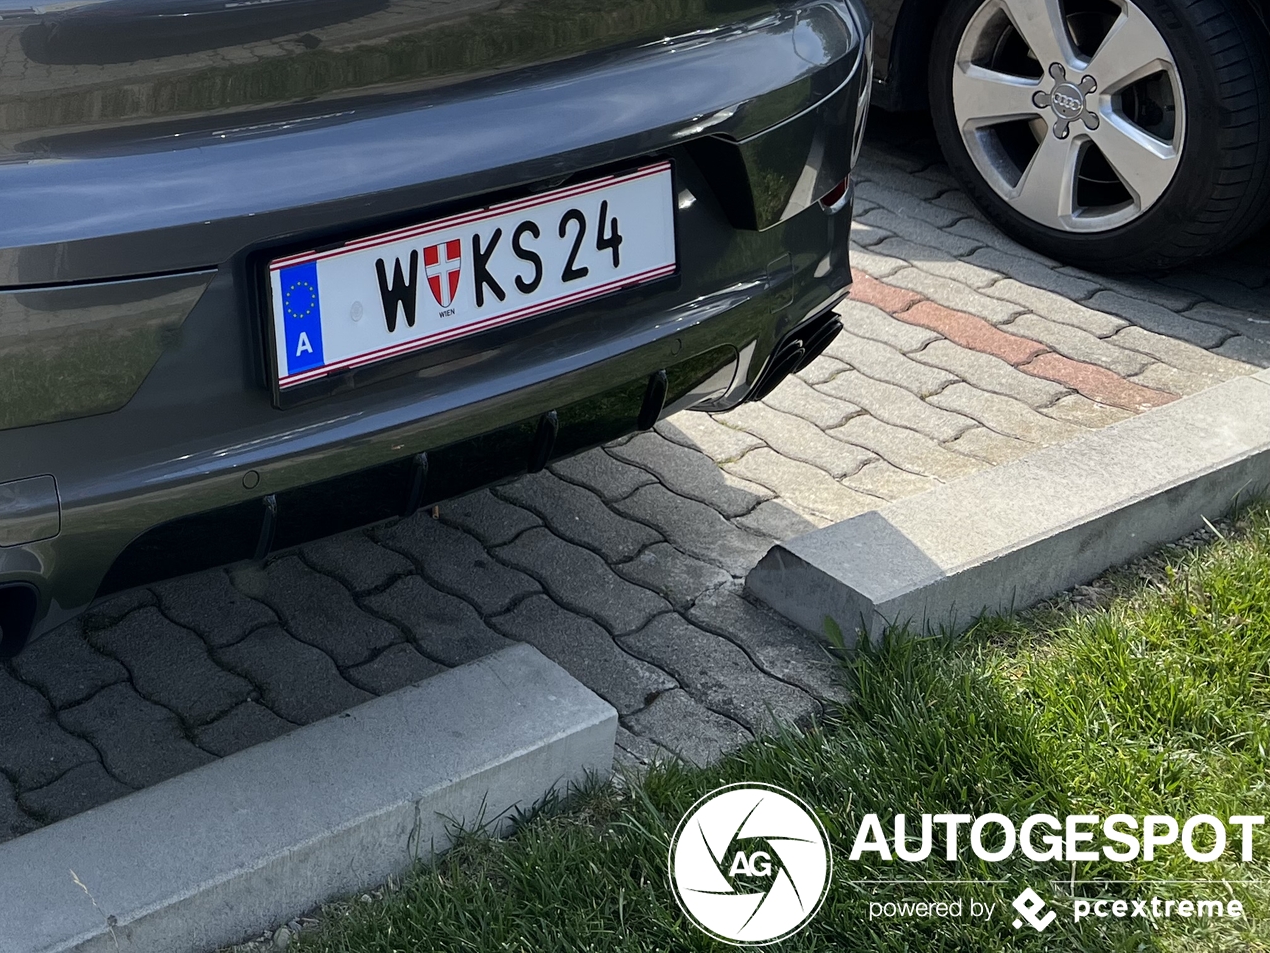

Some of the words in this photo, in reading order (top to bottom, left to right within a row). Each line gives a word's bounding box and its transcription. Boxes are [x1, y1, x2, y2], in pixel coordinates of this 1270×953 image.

[375, 250, 419, 333] W
[439, 308, 455, 318] WIEN
[294, 331, 313, 358] A
